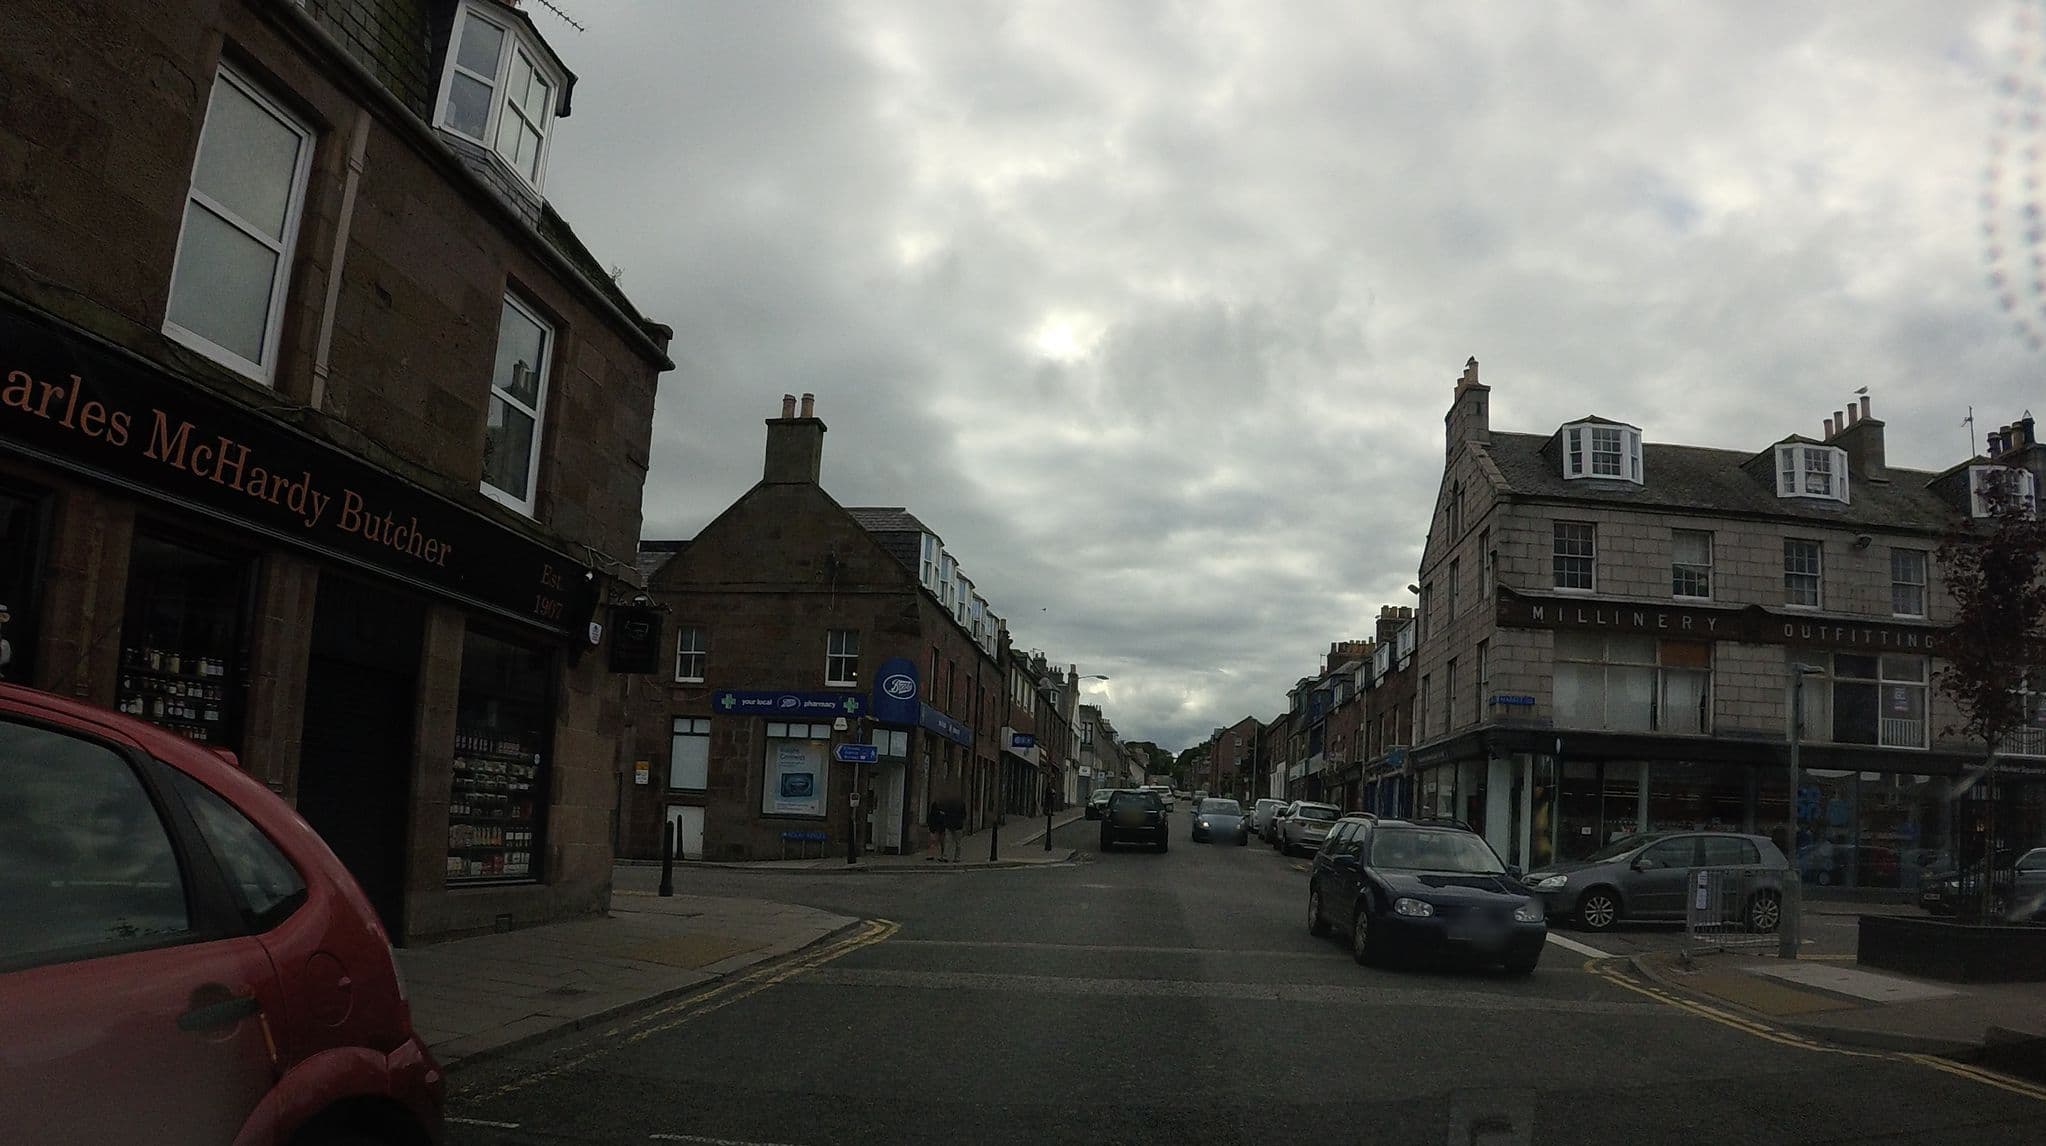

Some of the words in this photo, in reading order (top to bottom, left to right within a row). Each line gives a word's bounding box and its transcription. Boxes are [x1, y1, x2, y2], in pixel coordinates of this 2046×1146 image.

[1, 369, 132, 447] arles
[143, 408, 331, 528] McHardy
[336, 488, 452, 568] Butcher
[1532, 606, 1717, 632] MILLINERY
[1784, 623, 1936, 649] OUTFITTING
[741, 698, 757, 706] your
[757, 698, 773, 706] local
[803, 699, 836, 709] pharmacy
